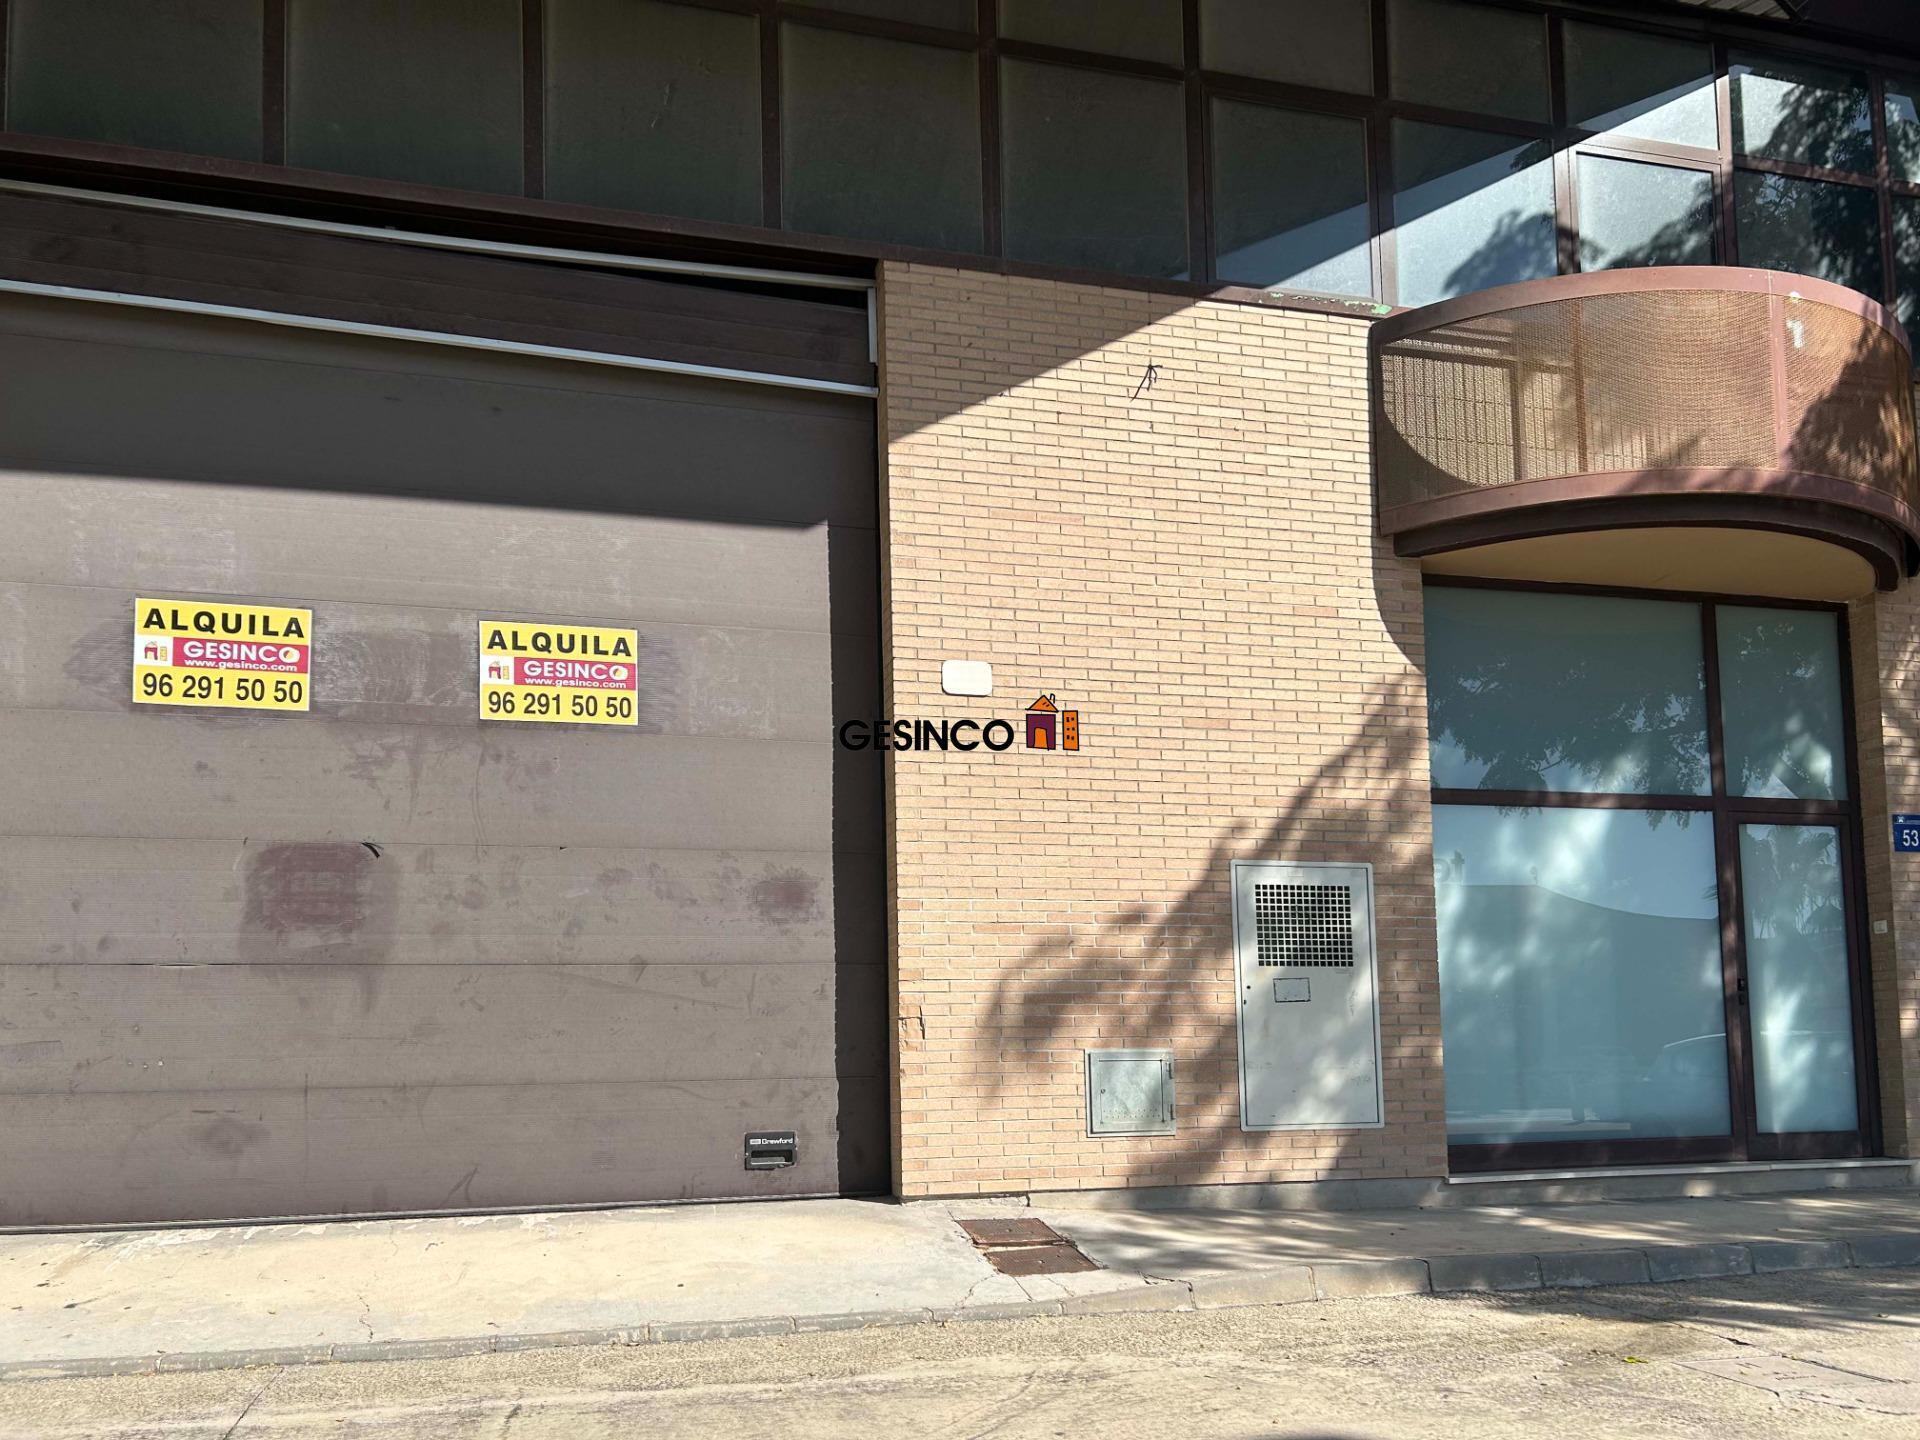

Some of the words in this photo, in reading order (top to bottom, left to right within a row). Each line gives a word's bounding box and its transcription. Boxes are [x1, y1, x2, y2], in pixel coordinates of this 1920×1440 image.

[143, 608, 304, 638] ALQUILA
[183, 640, 301, 664] GESINCO
[487, 629, 632, 657] ALQUILA
[184, 658, 298, 672] www.gesinco.com
[523, 660, 629, 681] GESINCO
[142, 672, 174, 697] 96
[182, 674, 224, 699] 291
[235, 677, 265, 702] 50
[273, 680, 303, 704] 50
[524, 677, 627, 689] www.gesinco.com
[488, 690, 515, 714] 96
[523, 692, 561, 715] 291
[571, 694, 598, 717] 50
[605, 696, 632, 718] 50
[1903, 829, 1919, 846] 53
